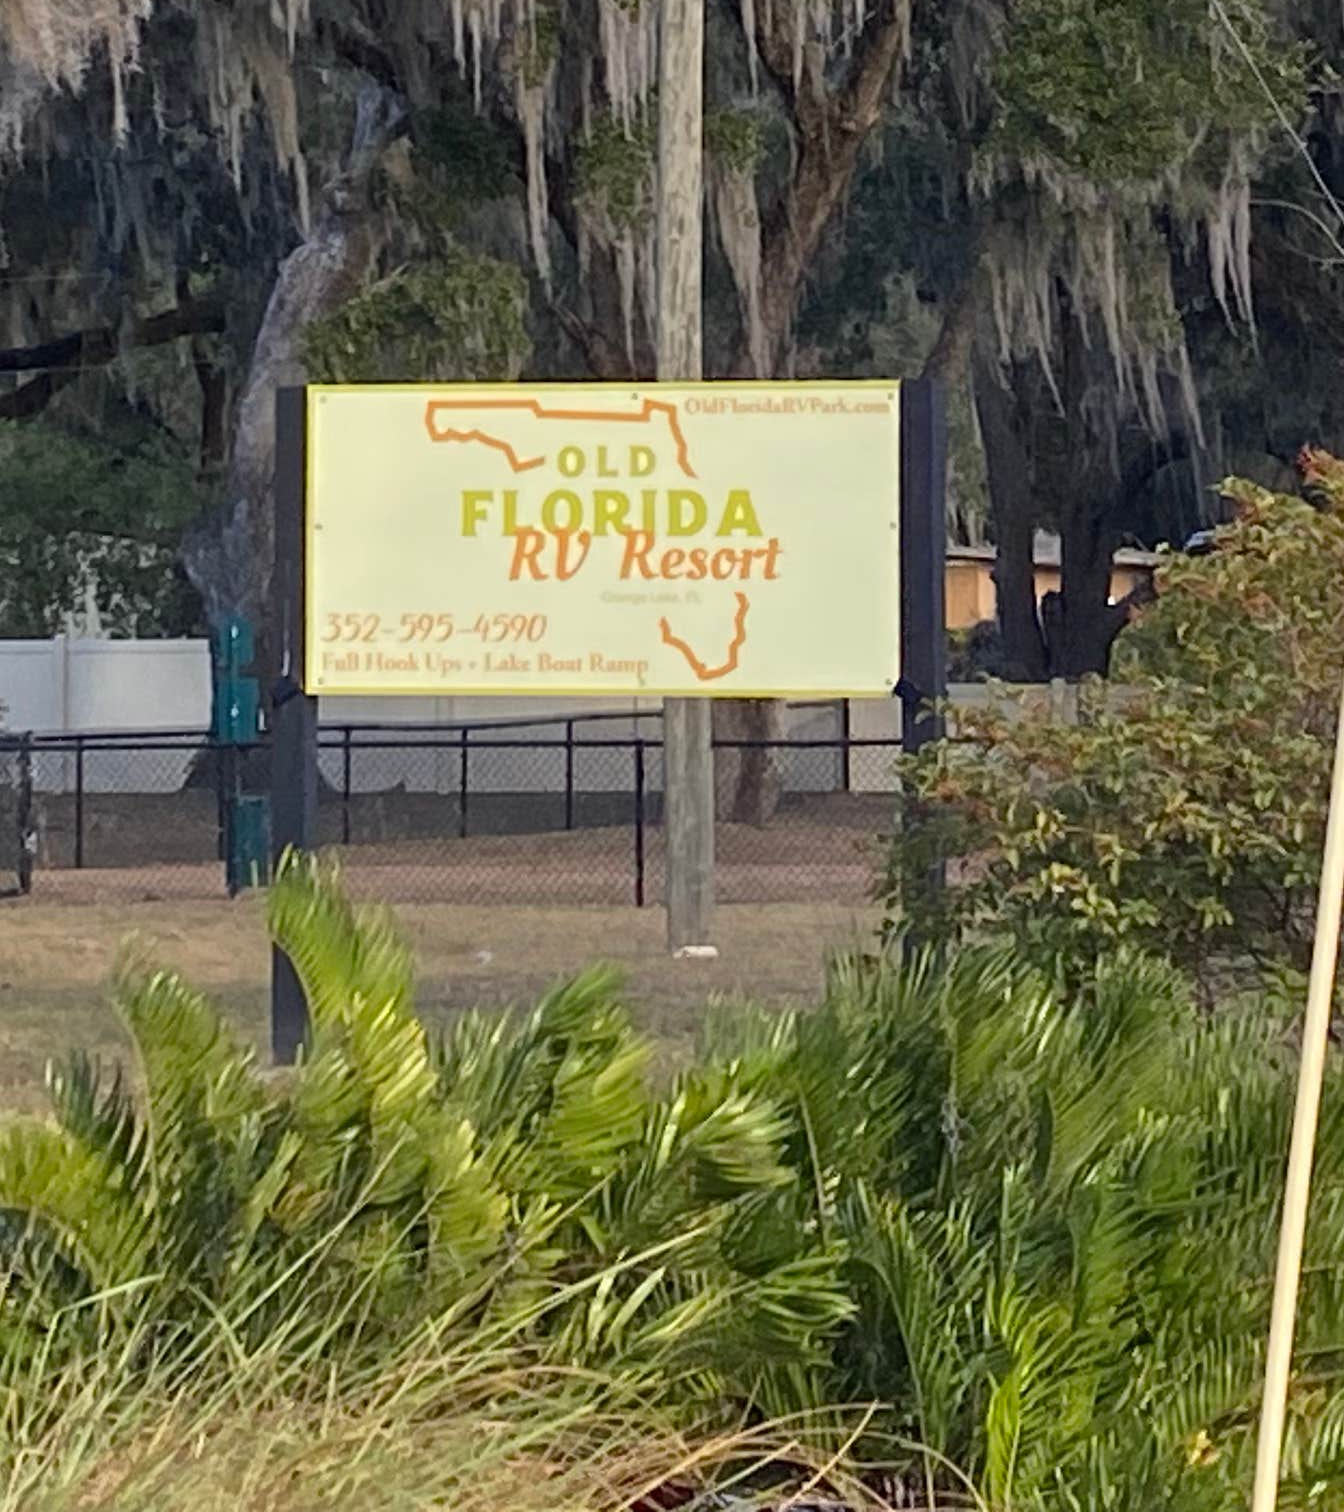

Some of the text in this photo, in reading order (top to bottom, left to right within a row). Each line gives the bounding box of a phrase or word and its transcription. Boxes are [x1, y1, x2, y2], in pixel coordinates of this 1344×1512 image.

[557, 445, 657, 478] OLD
[460, 489, 764, 537] FLORIDA
[508, 526, 784, 581] RV Resort
[321, 613, 549, 644] 352-595-4590
[321, 651, 650, 678] Full Hook Ups Lake Boat Ramp
